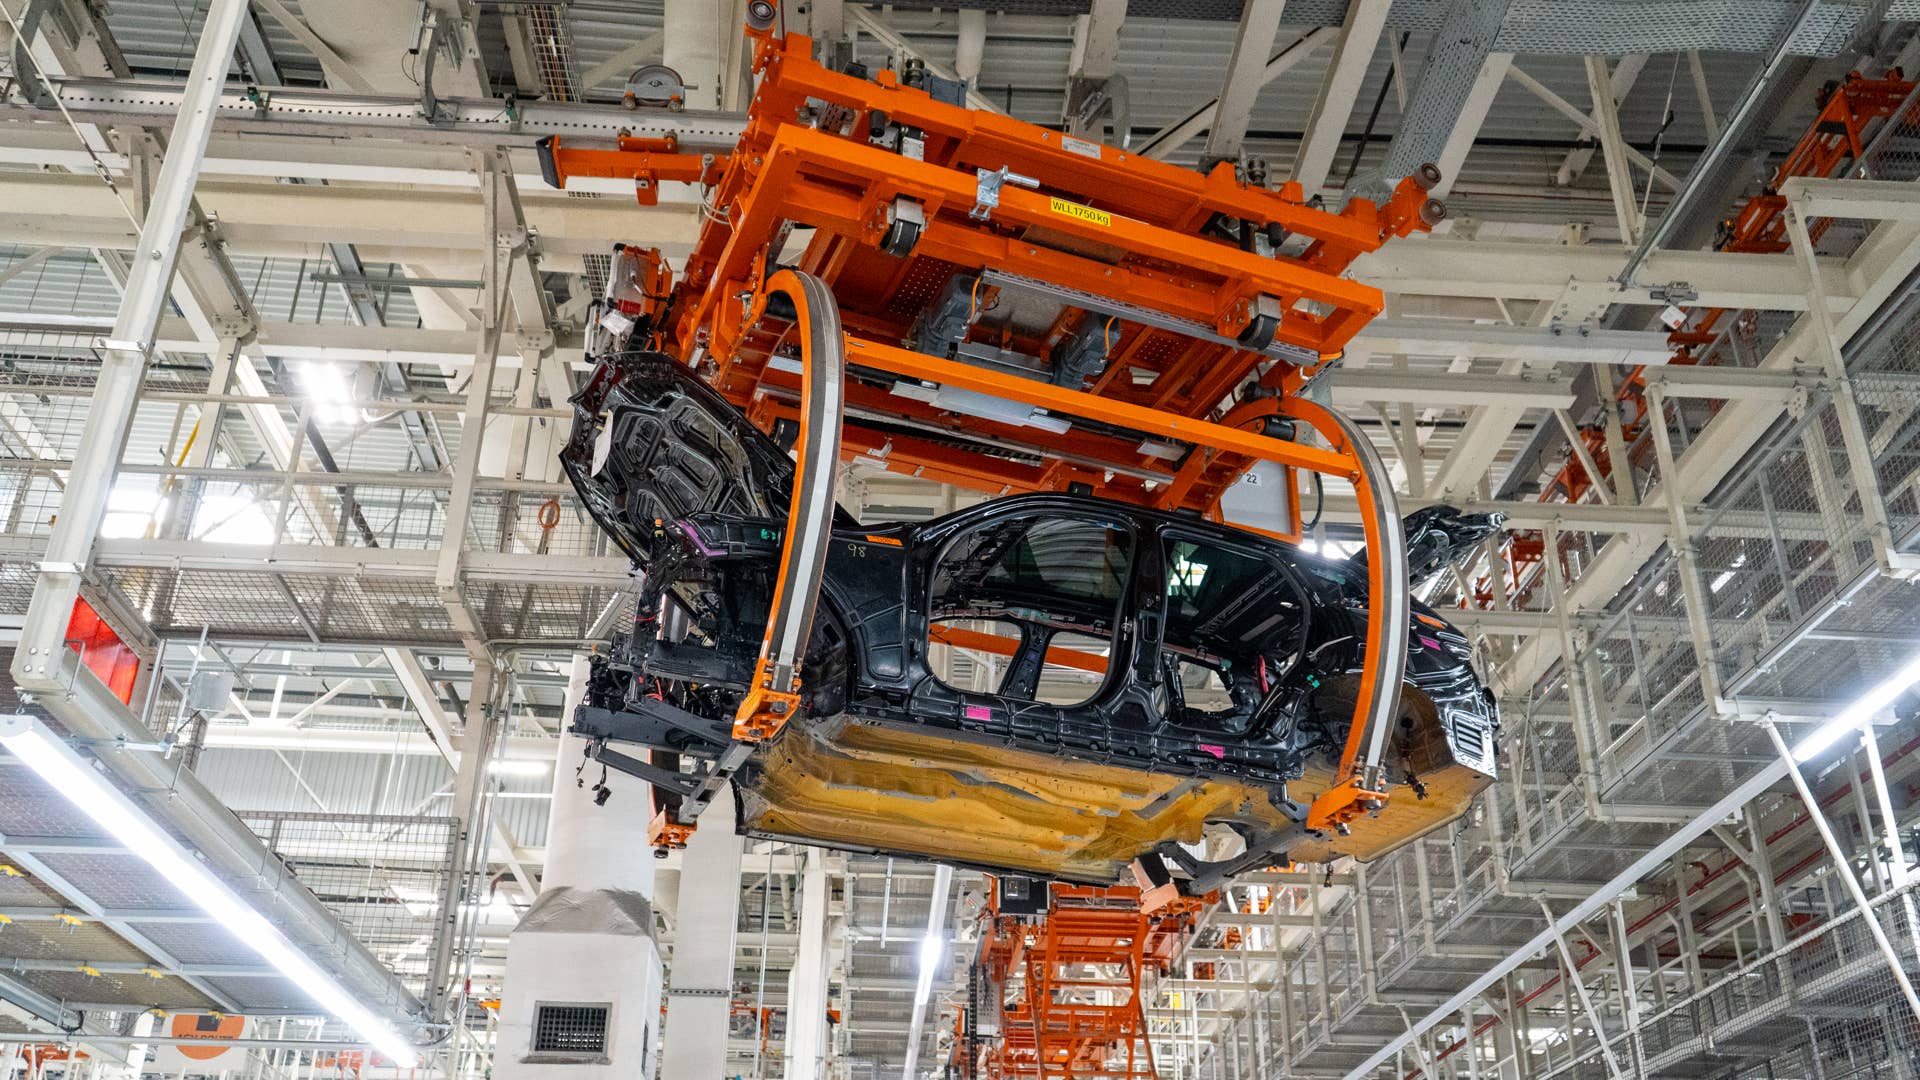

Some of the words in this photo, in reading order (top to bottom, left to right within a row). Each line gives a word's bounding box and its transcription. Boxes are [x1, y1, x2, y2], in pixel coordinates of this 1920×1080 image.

[1074, 207, 1096, 220] 1750
[1096, 213, 1109, 226] kg
[847, 543, 867, 558] 98
